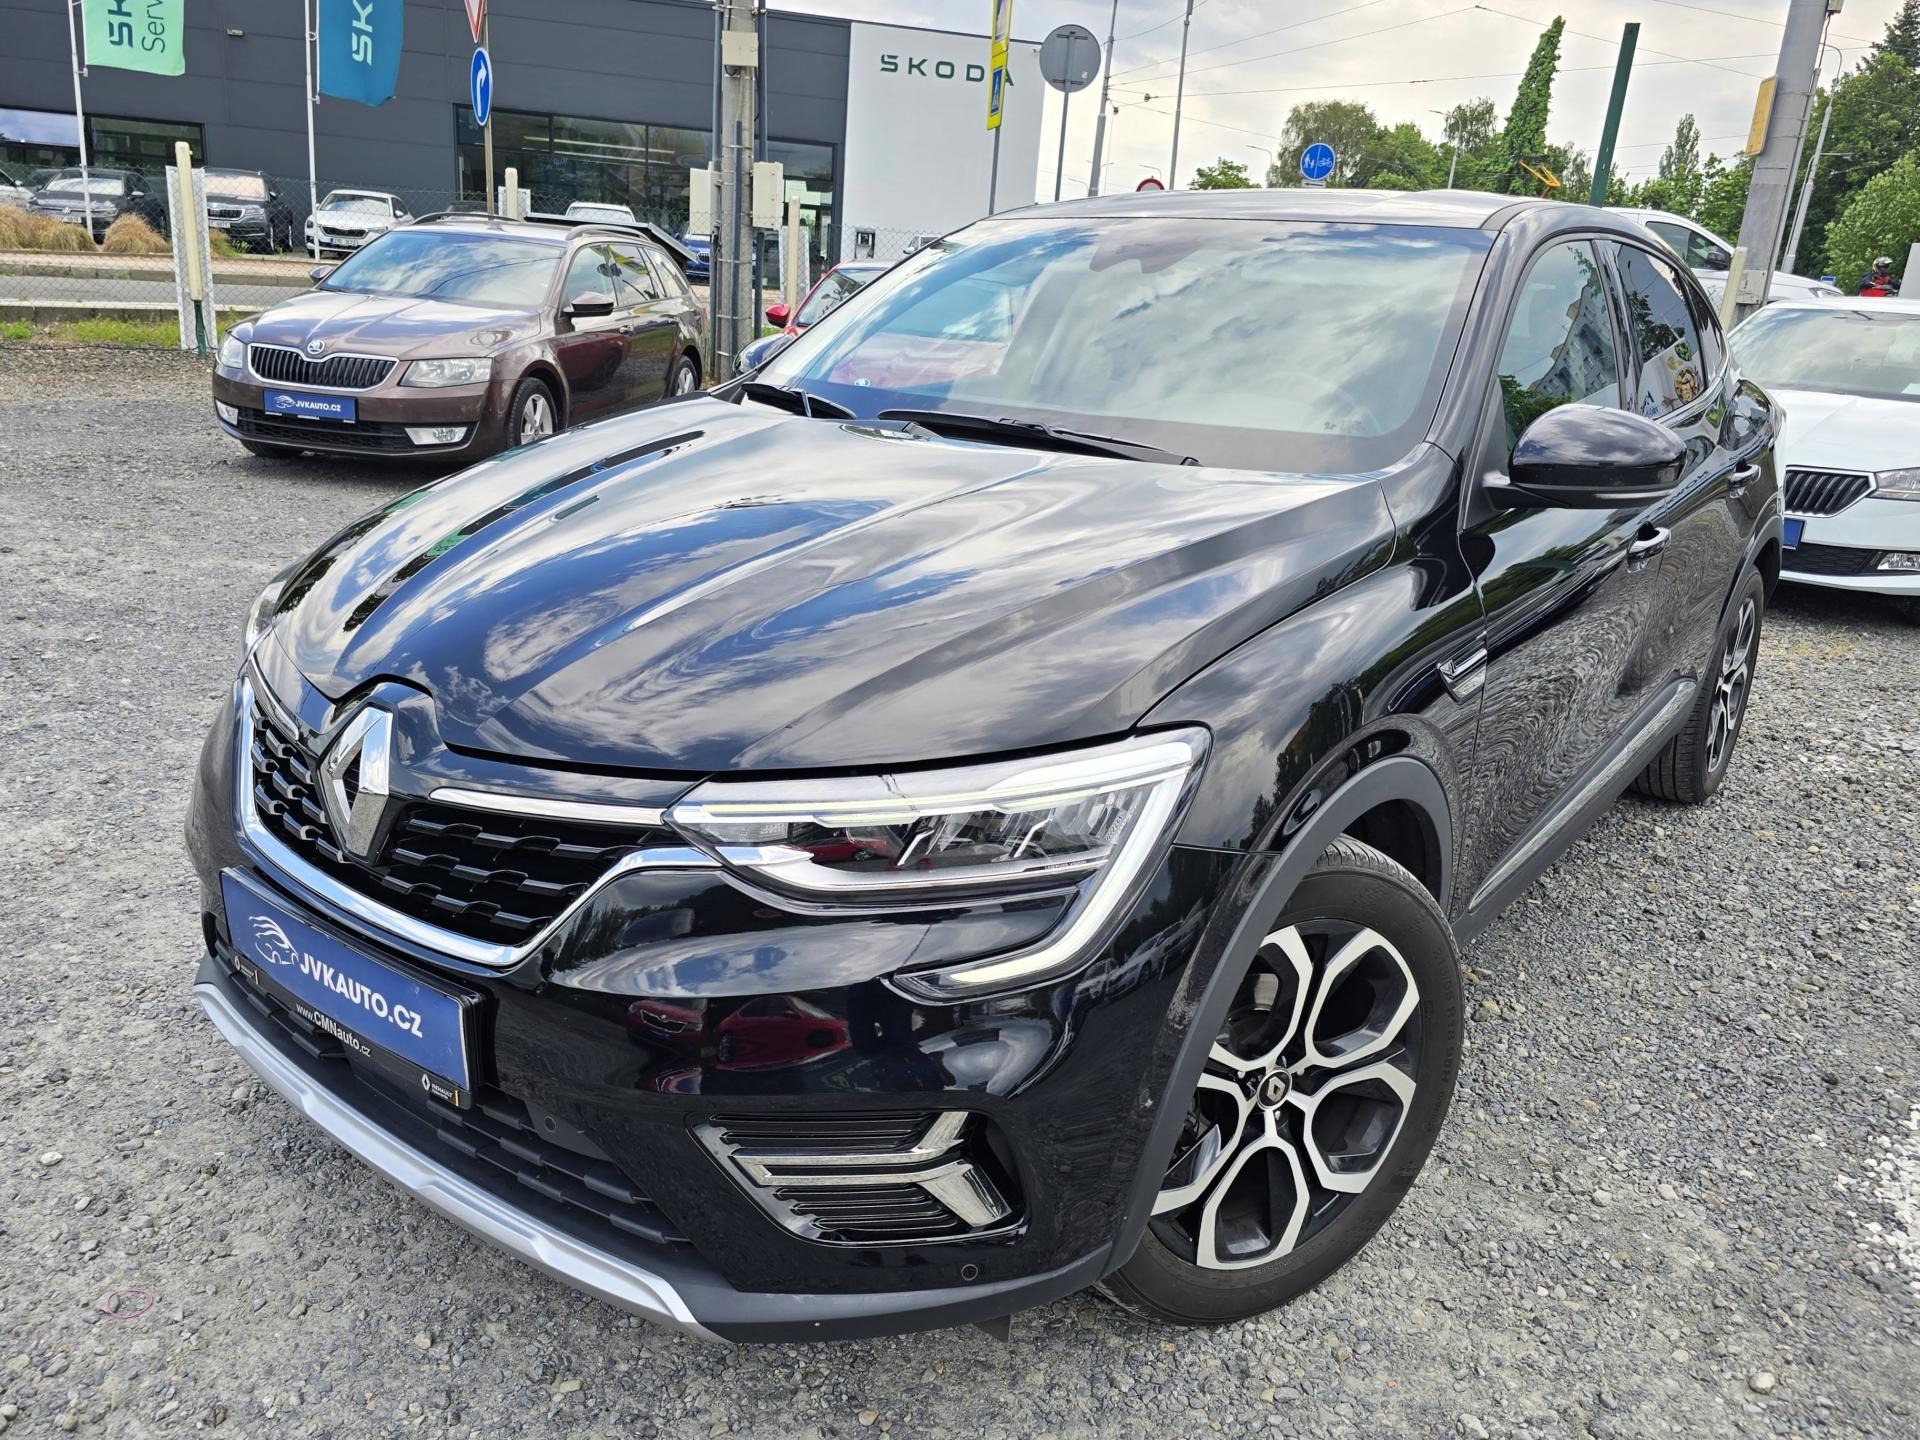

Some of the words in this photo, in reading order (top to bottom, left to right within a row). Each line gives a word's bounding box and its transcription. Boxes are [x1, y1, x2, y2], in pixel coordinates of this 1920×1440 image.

[295, 400, 342, 412] JVKAUTO.CZ
[300, 952, 423, 1039] JVKAUTO.CZ
[295, 1003, 372, 1058] www.CMNauto.cz
